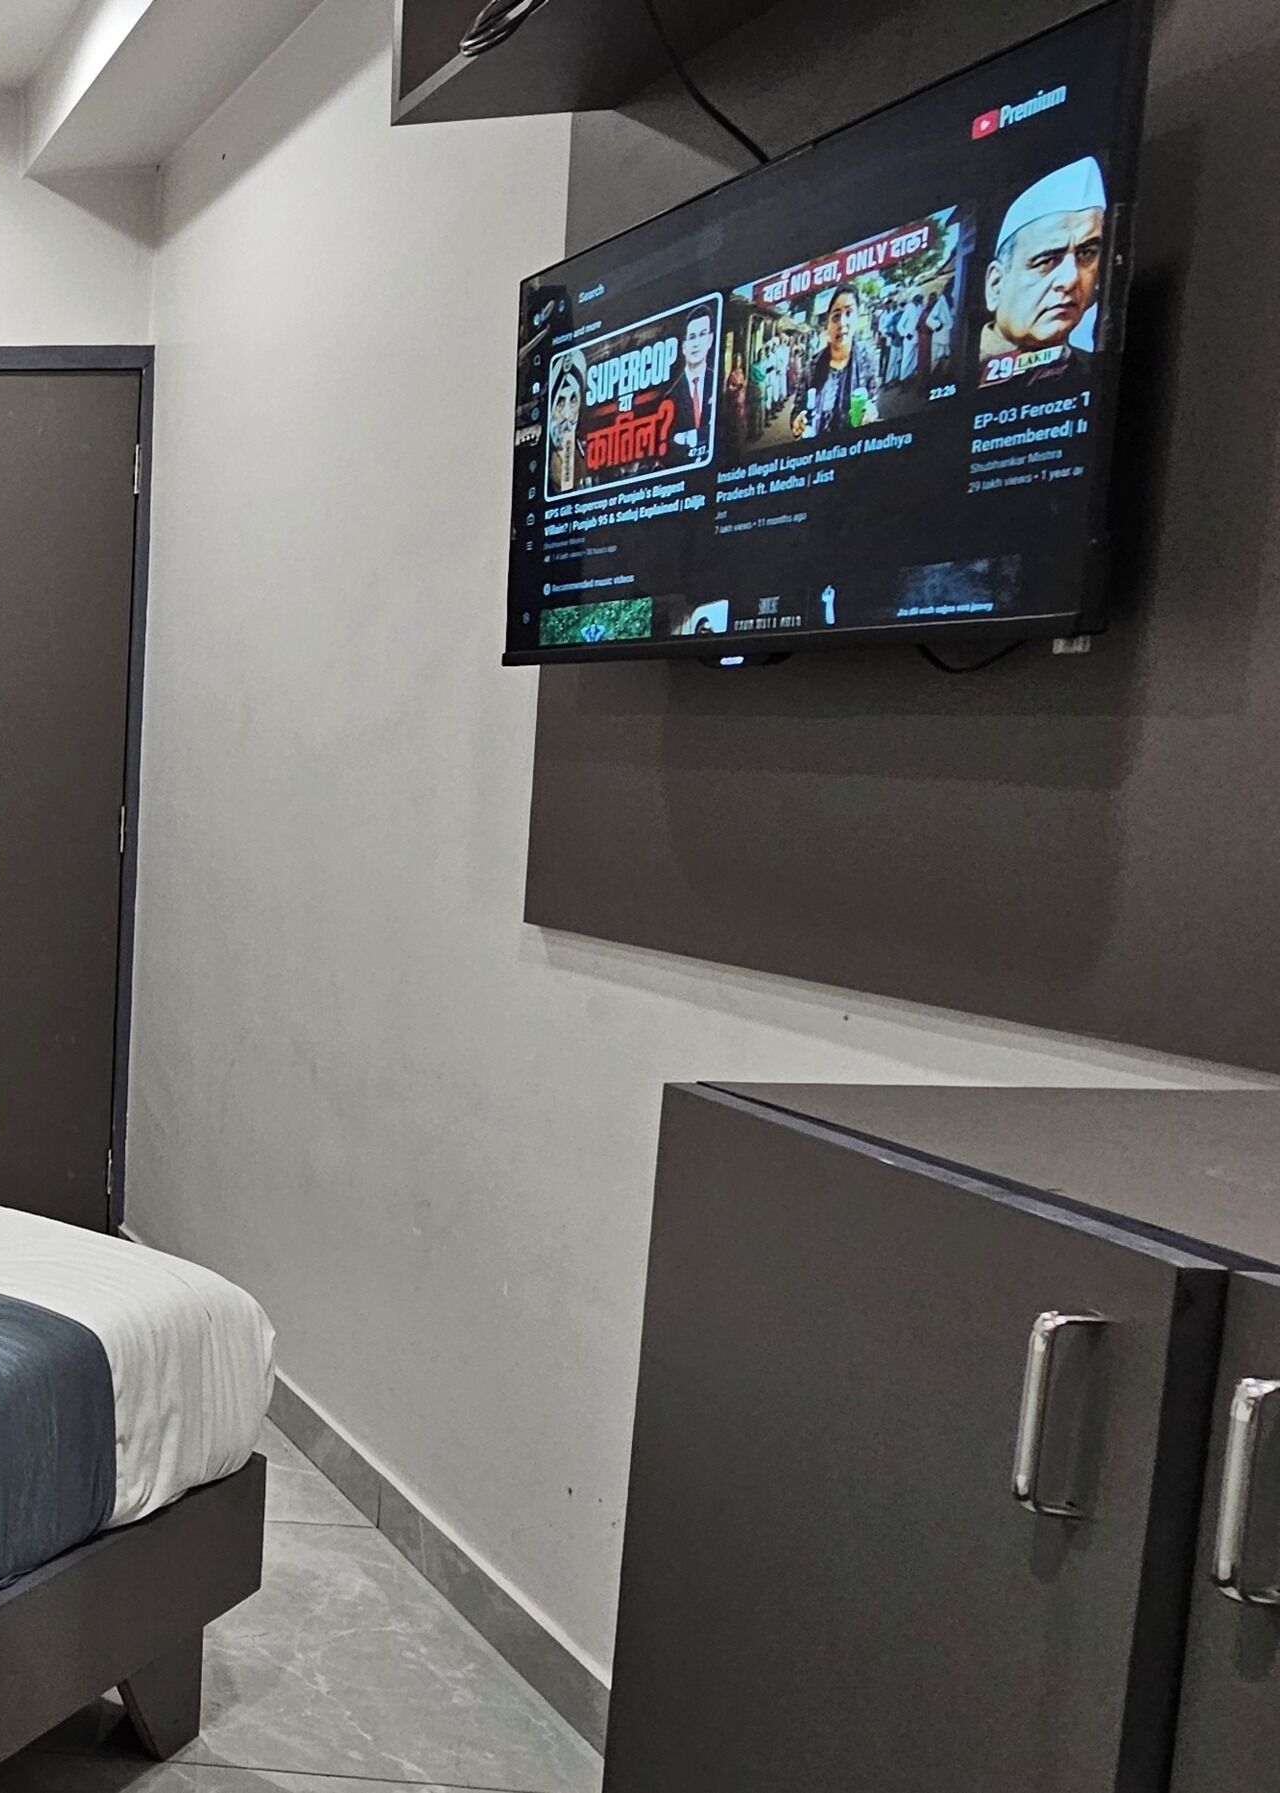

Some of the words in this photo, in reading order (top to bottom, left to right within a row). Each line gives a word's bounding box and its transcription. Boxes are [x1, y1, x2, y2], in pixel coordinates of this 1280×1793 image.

[1000, 85, 1067, 128] Premium
[790, 272, 811, 295] NO
[845, 242, 888, 274] ONLY
[578, 283, 605, 303] Search
[552, 332, 573, 346] History
[573, 326, 585, 338] and
[585, 320, 602, 333] more
[586, 337, 679, 406] SUPERCOP
[987, 357, 1014, 381] 29
[1018, 351, 1052, 368] LAKH
[618, 393, 633, 412] या
[973, 407, 1017, 430] EP-03
[1020, 397, 1078, 419] Feroze:
[586, 397, 675, 470] कातिल?
[717, 467, 746, 484] Inside
[748, 459, 778, 478] Illegal
[779, 453, 814, 473] Liquor
[815, 446, 847, 463] Mafia
[849, 440, 862, 456] of
[864, 432, 913, 453] Madhya
[716, 487, 755, 503] Pradesh
[757, 484, 768, 495] ft.
[770, 476, 806, 494] Medha
[812, 469, 835, 485] Jist
[967, 480, 981, 493] 29
[982, 477, 1002, 490] lakh
[1004, 474, 1033, 486] views
[1048, 467, 1071, 481] year
[574, 498, 608, 515] Supercop
[608, 496, 618, 506] or
[618, 487, 652, 505] Punjab's
[652, 481, 685, 498] Biggest
[573, 516, 598, 531] Punjab
[598, 513, 609, 525] 95
[640, 501, 679, 519] Explained
[552, 577, 594, 593] Recommended
[594, 577, 613, 587] music
[613, 574, 636, 585] videos
